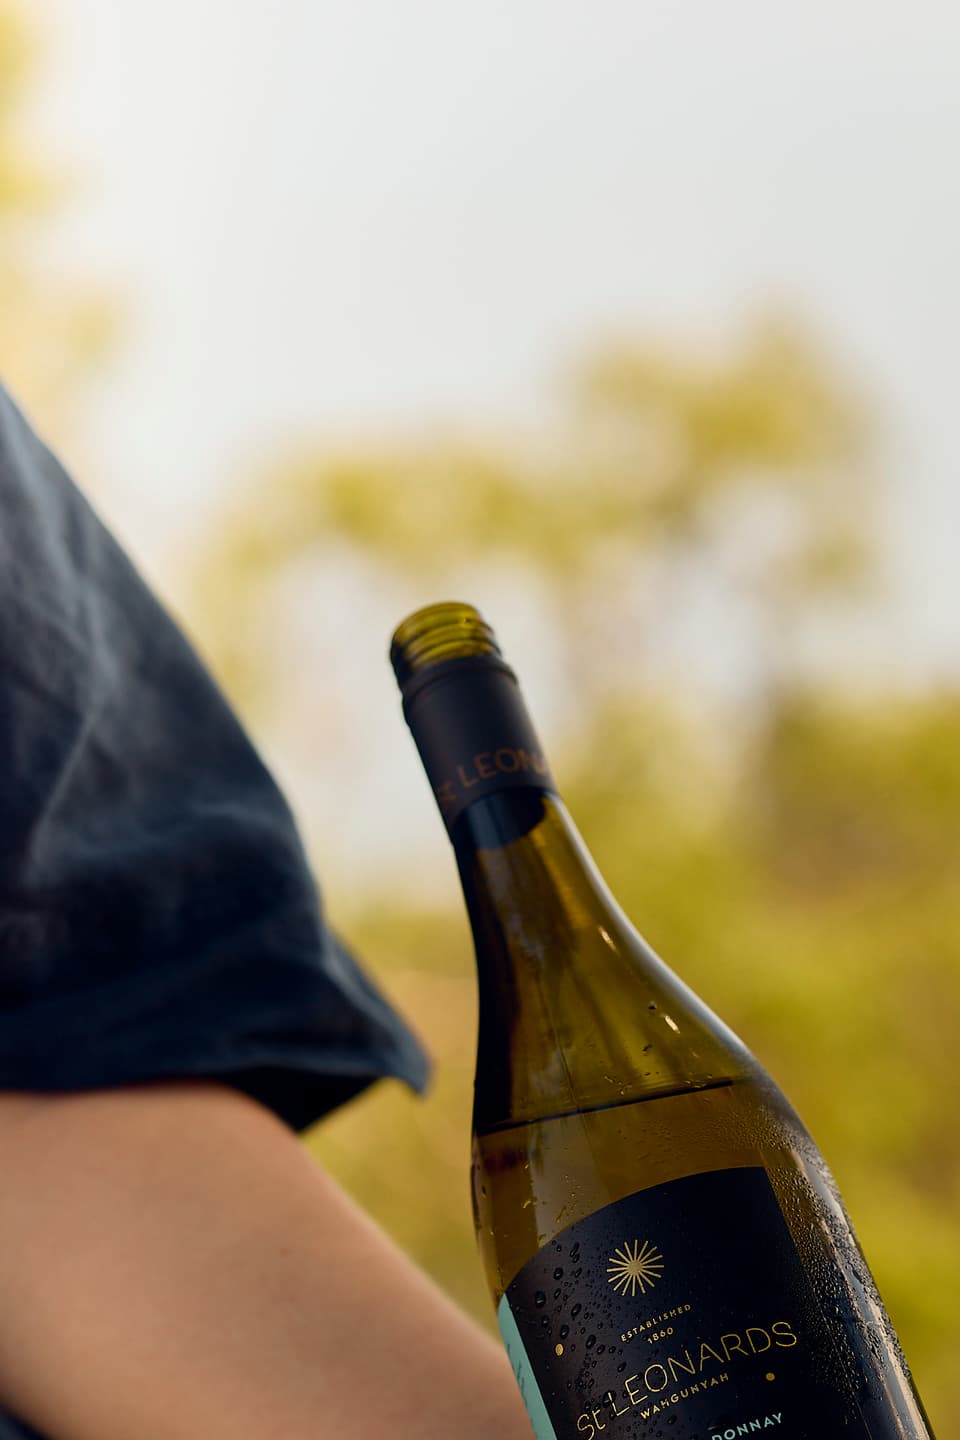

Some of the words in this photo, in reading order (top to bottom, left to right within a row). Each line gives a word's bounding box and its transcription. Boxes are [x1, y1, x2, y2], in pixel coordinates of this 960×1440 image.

[620, 1304, 692, 1342] ESTABLISHED
[647, 1327, 674, 1344] 1860
[608, 1321, 797, 1417] LEONARDS
[640, 1373, 729, 1419] WAHGUNYAH
